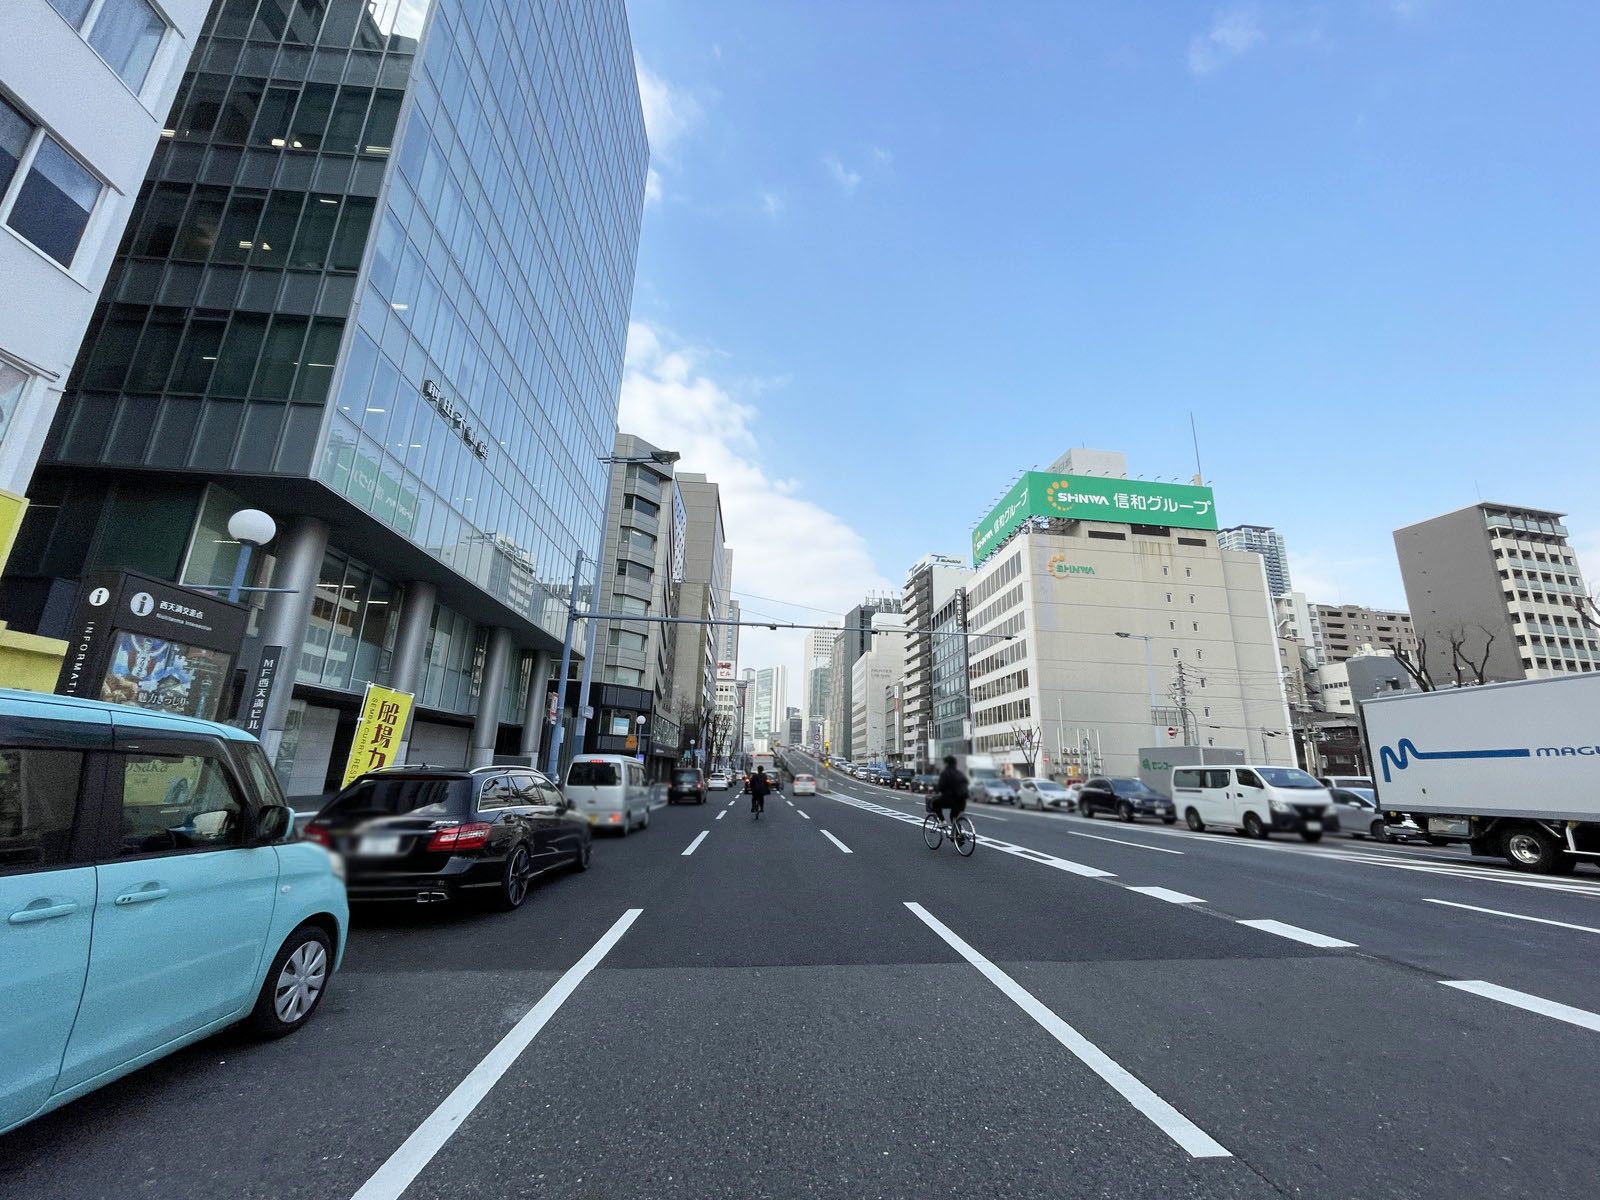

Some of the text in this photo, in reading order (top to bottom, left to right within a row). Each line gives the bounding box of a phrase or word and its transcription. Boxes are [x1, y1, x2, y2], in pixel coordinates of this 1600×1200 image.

[1113, 492, 1212, 515] 信和グループ
[160, 601, 204, 619] 西天満交差点
[247, 659, 274, 729] MF西天満ビル
[358, 727, 370, 755] CURRY
